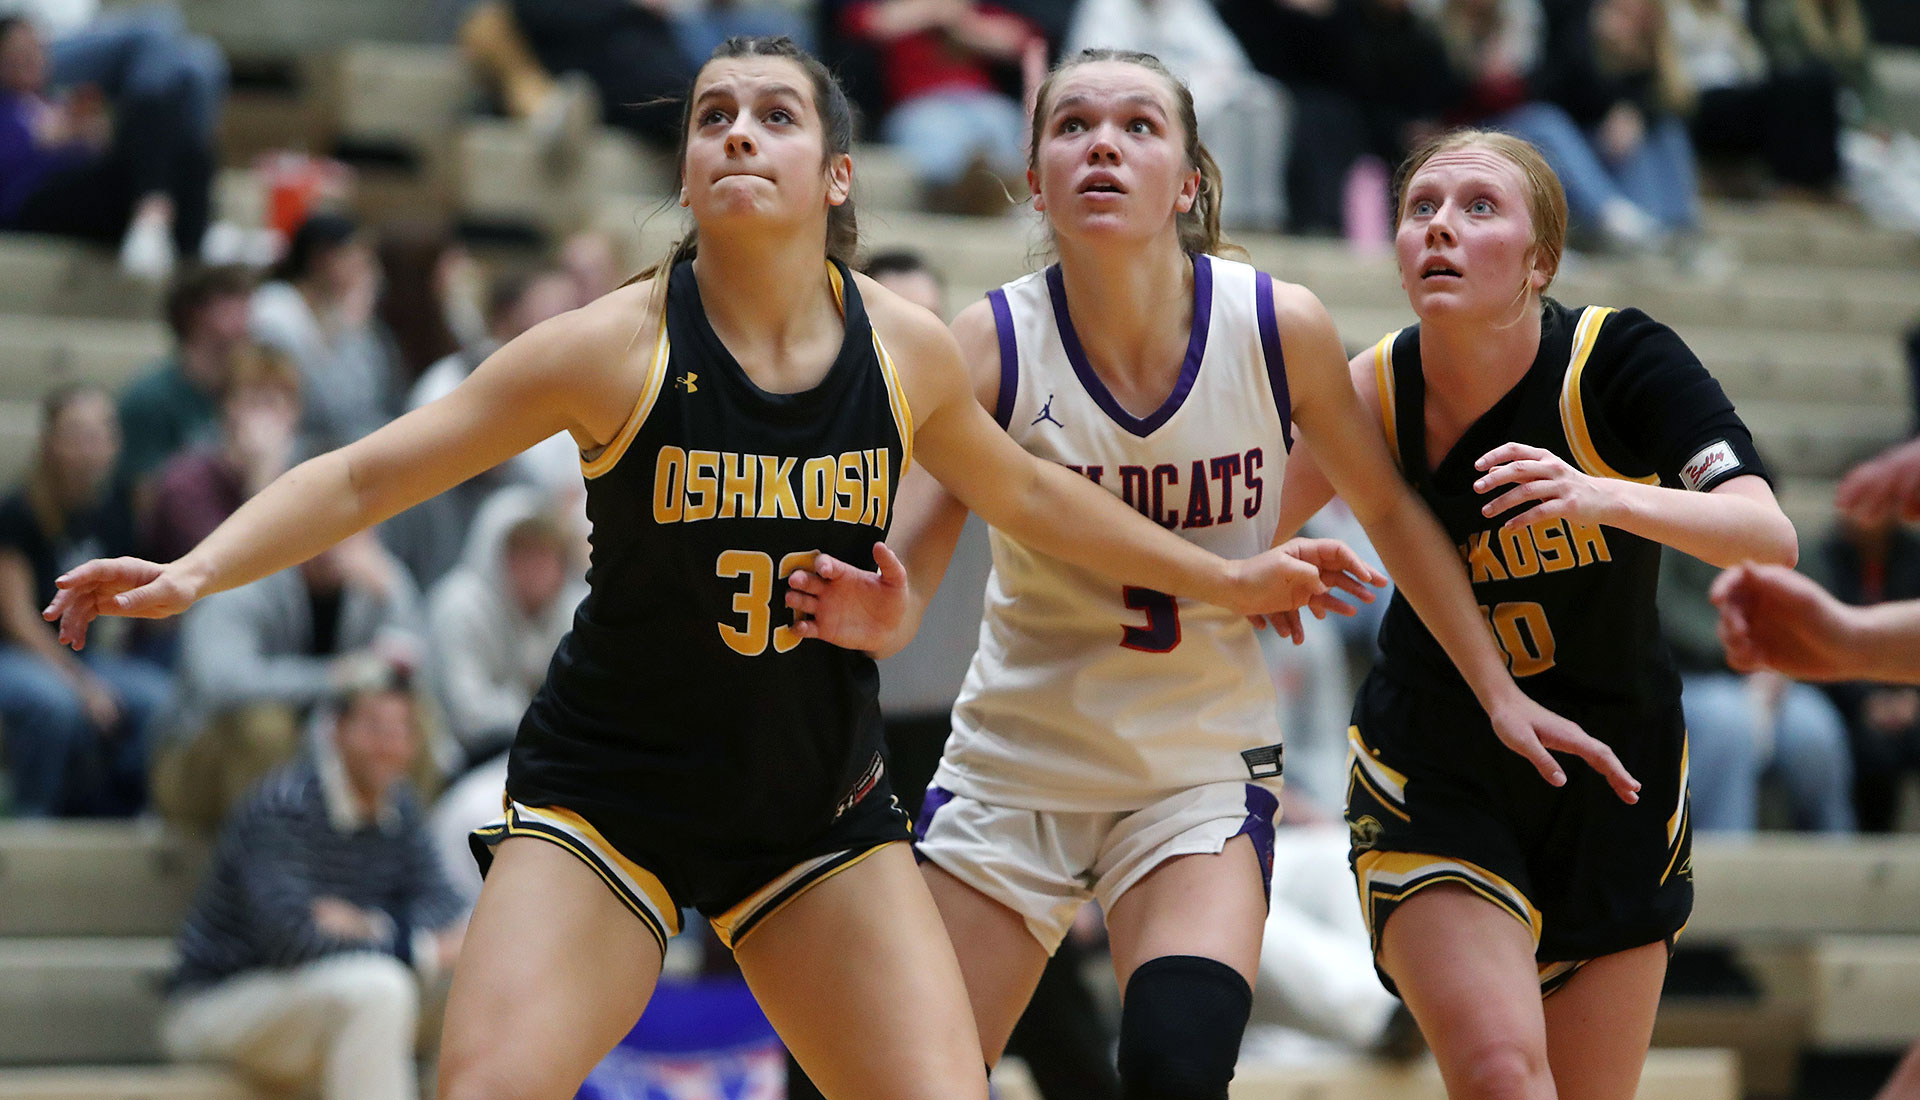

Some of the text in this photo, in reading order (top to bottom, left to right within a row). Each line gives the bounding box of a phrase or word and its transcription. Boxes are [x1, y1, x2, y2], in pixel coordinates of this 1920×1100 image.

[653, 445, 890, 531] OSHKOSH
[1057, 447, 1264, 530] DCATS
[1459, 516, 1613, 583] KOSH
[1478, 601, 1556, 678] 0
